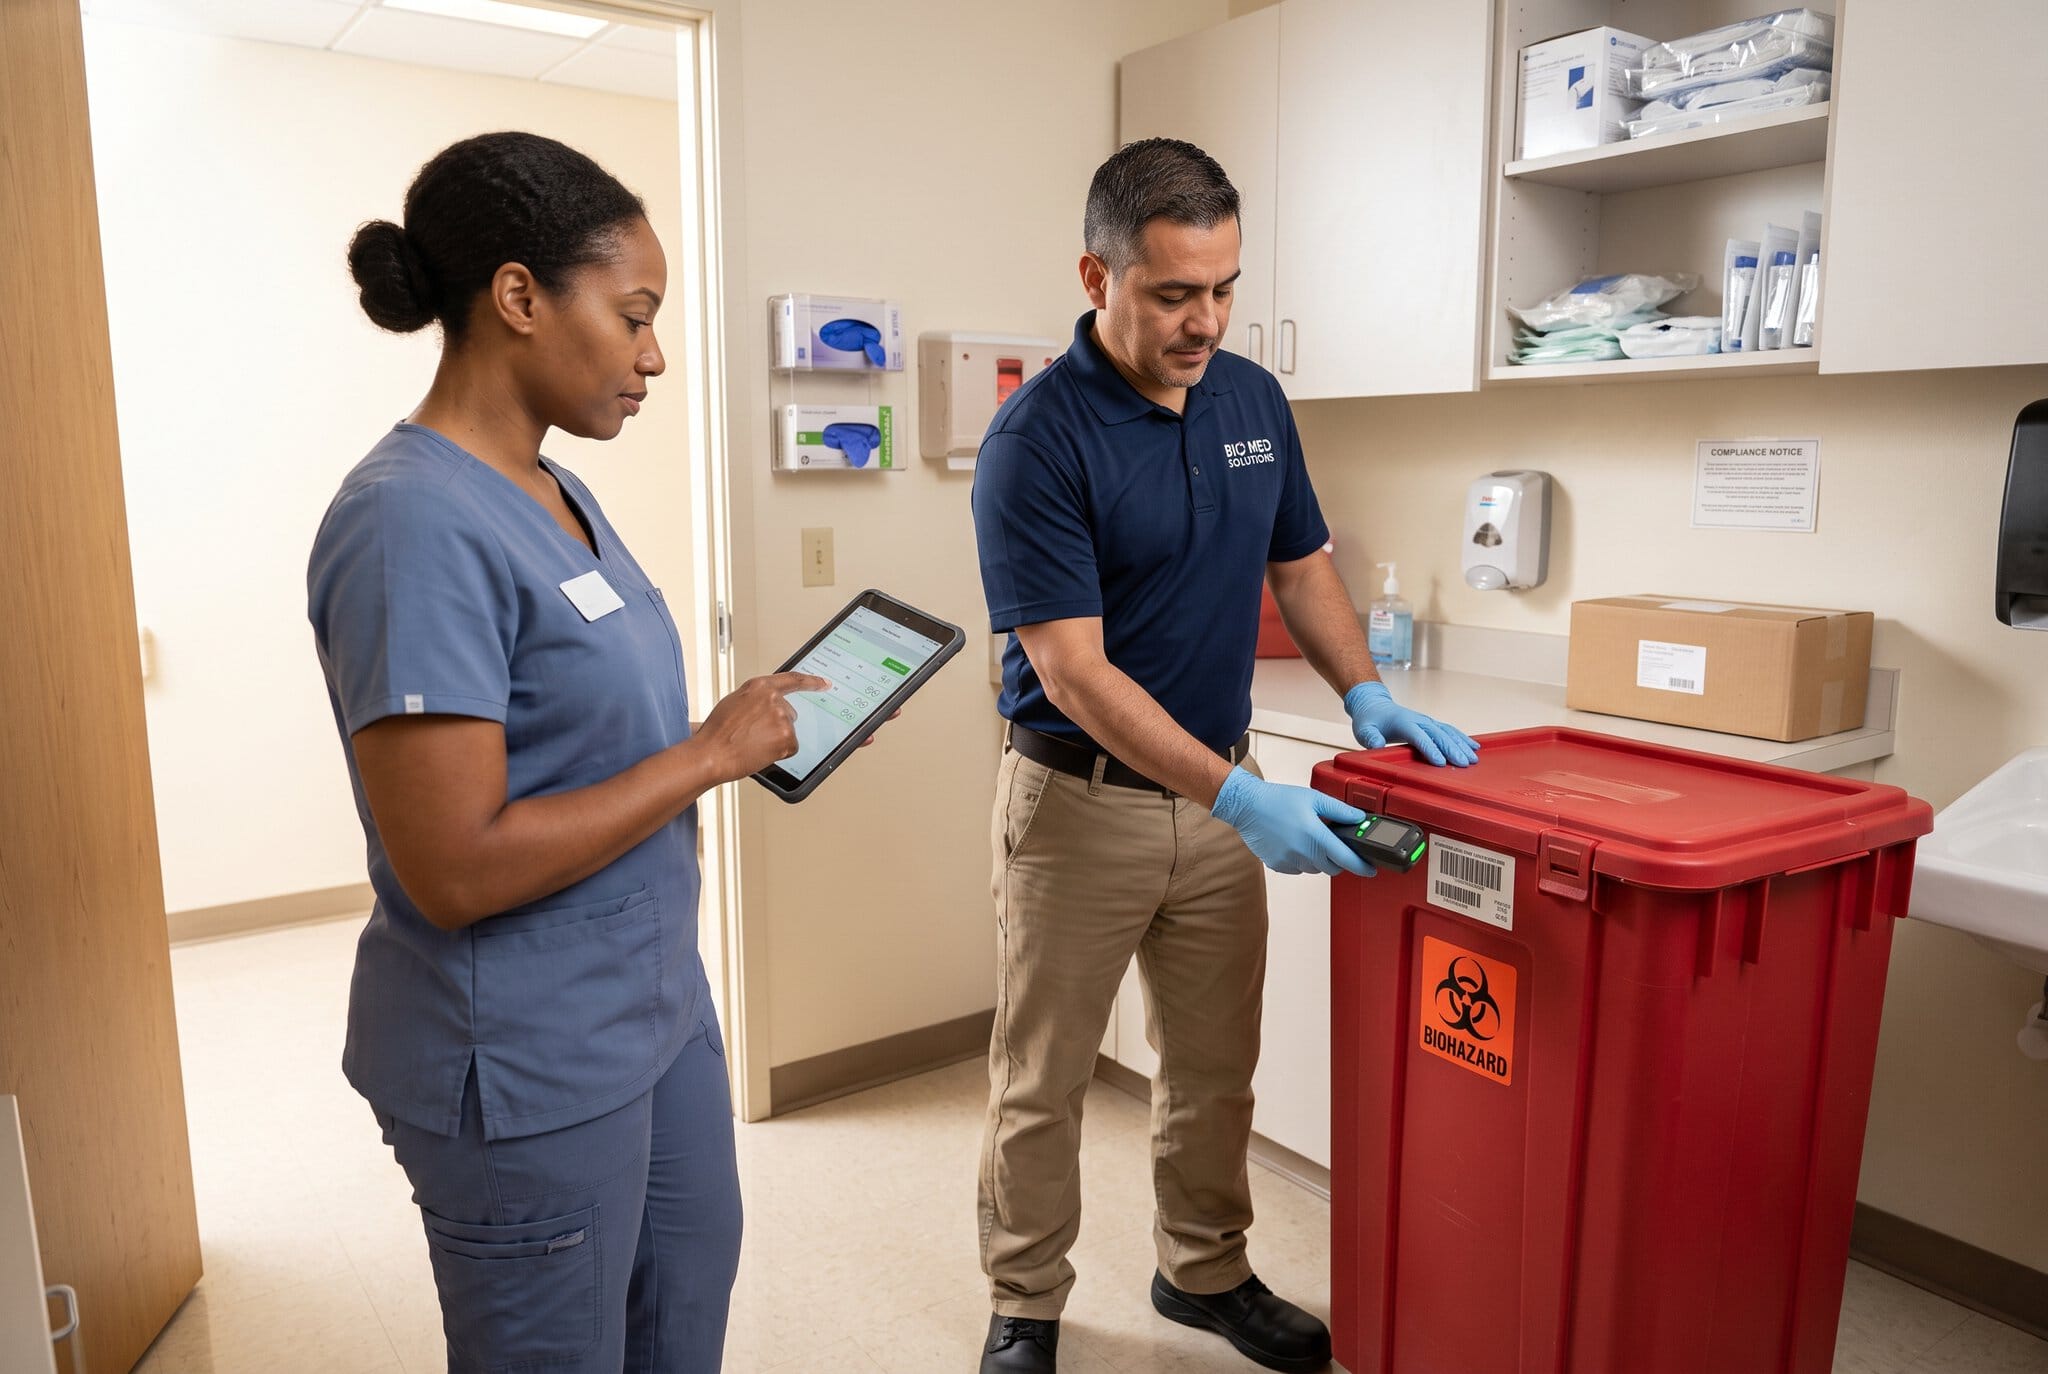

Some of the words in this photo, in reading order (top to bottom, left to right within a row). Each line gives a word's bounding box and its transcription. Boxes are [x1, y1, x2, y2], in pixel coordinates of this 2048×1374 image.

[1224, 441, 1246, 457] BIO
[1247, 439, 1271, 453] MED
[1711, 448, 1767, 456] COMPLIANCE
[1769, 448, 1803, 456] NOTICE
[1228, 453, 1275, 468] SOLUTIONS
[1424, 1025, 1508, 1077] BIOHAZARD
